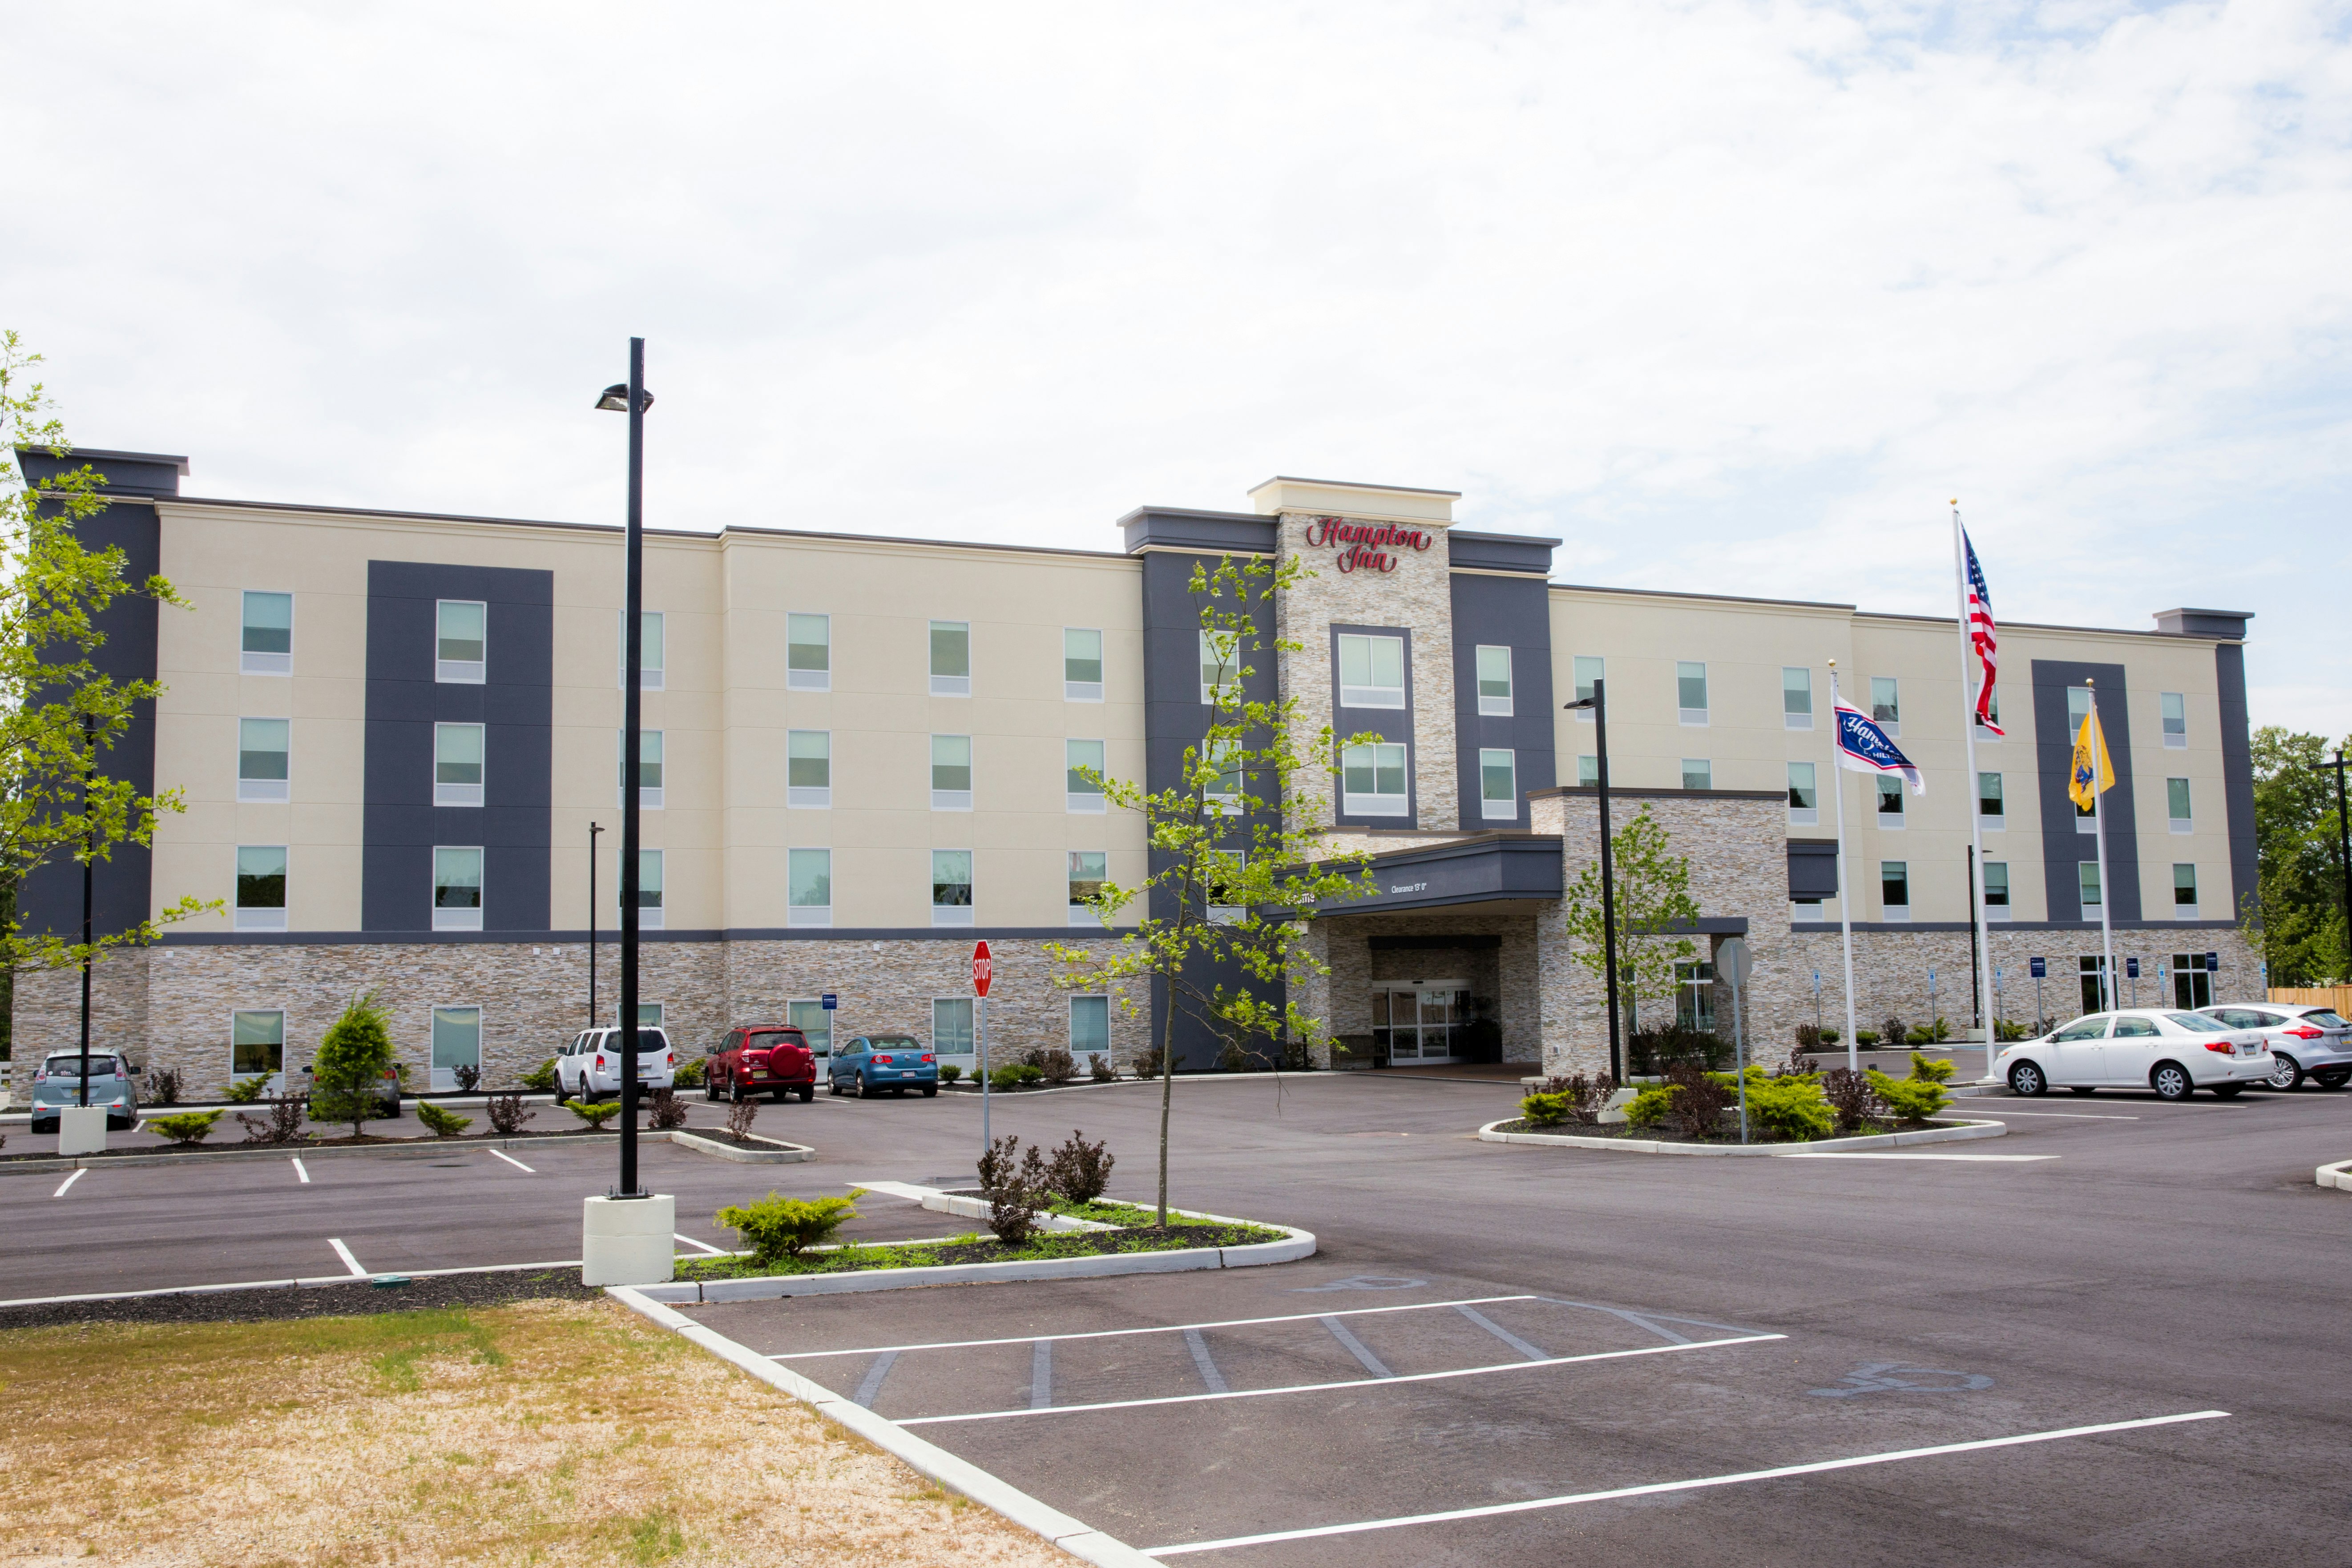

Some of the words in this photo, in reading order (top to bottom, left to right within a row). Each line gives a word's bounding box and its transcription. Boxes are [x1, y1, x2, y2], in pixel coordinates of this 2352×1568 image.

[1306, 517, 1432, 551] Hampton
[1338, 544, 1397, 573] Inn
[1872, 752, 1903, 761] HILTON
[1391, 885, 1414, 894] Clearance
[974, 958, 991, 980] STOP
